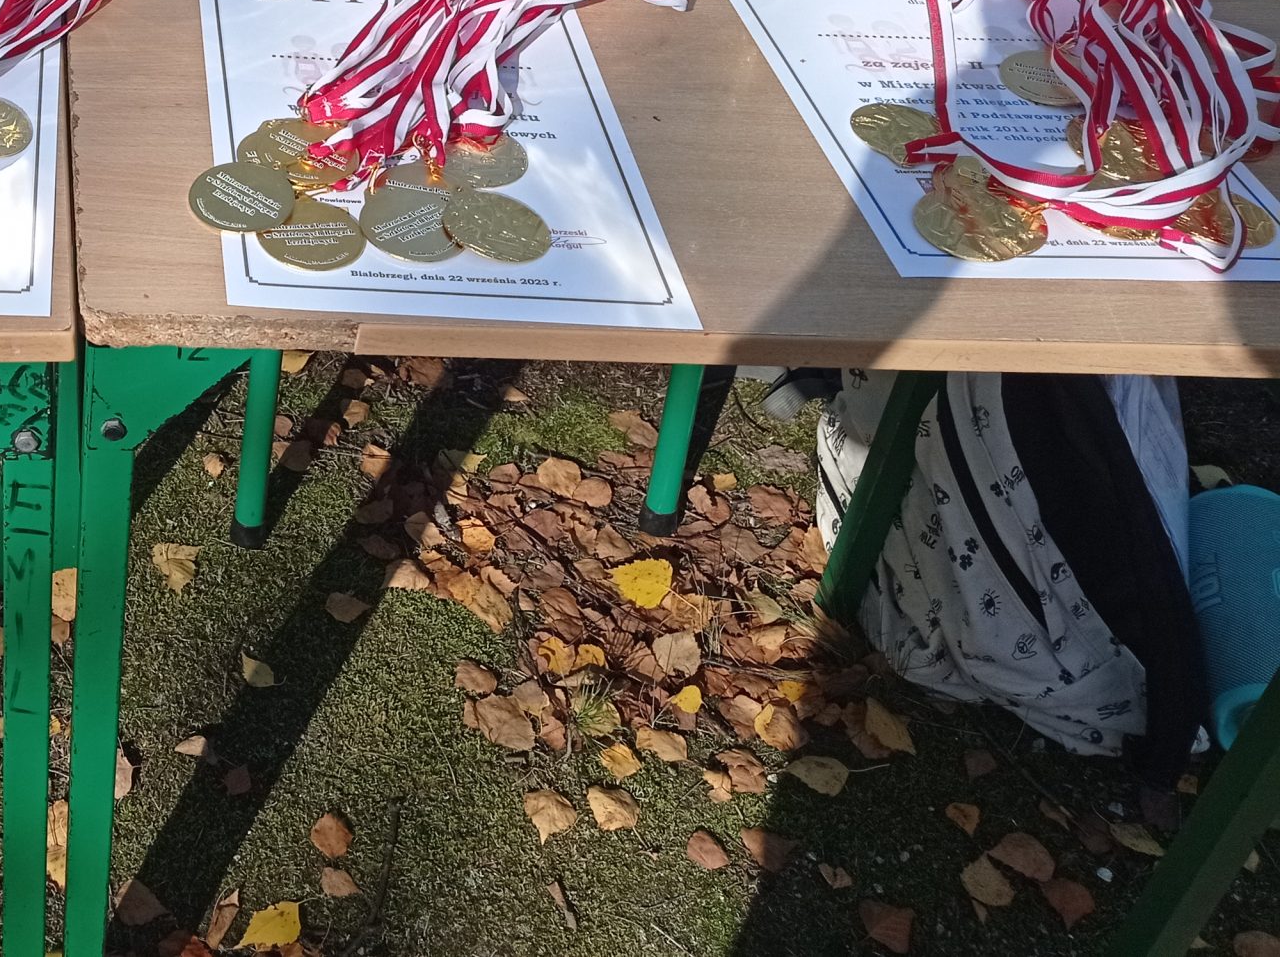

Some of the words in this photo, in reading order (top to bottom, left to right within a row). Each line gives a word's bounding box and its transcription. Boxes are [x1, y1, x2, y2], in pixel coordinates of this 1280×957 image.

[862, 60, 886, 68] za
[858, 81, 872, 89] w
[973, 97, 1031, 107] Biegach
[993, 125, 1029, 134] 2011
[1066, 239, 1090, 247] dnia
[420, 273, 445, 282] dnia
[448, 274, 463, 283] 22
[466, 276, 517, 285] września
[520, 277, 550, 286] 2023
